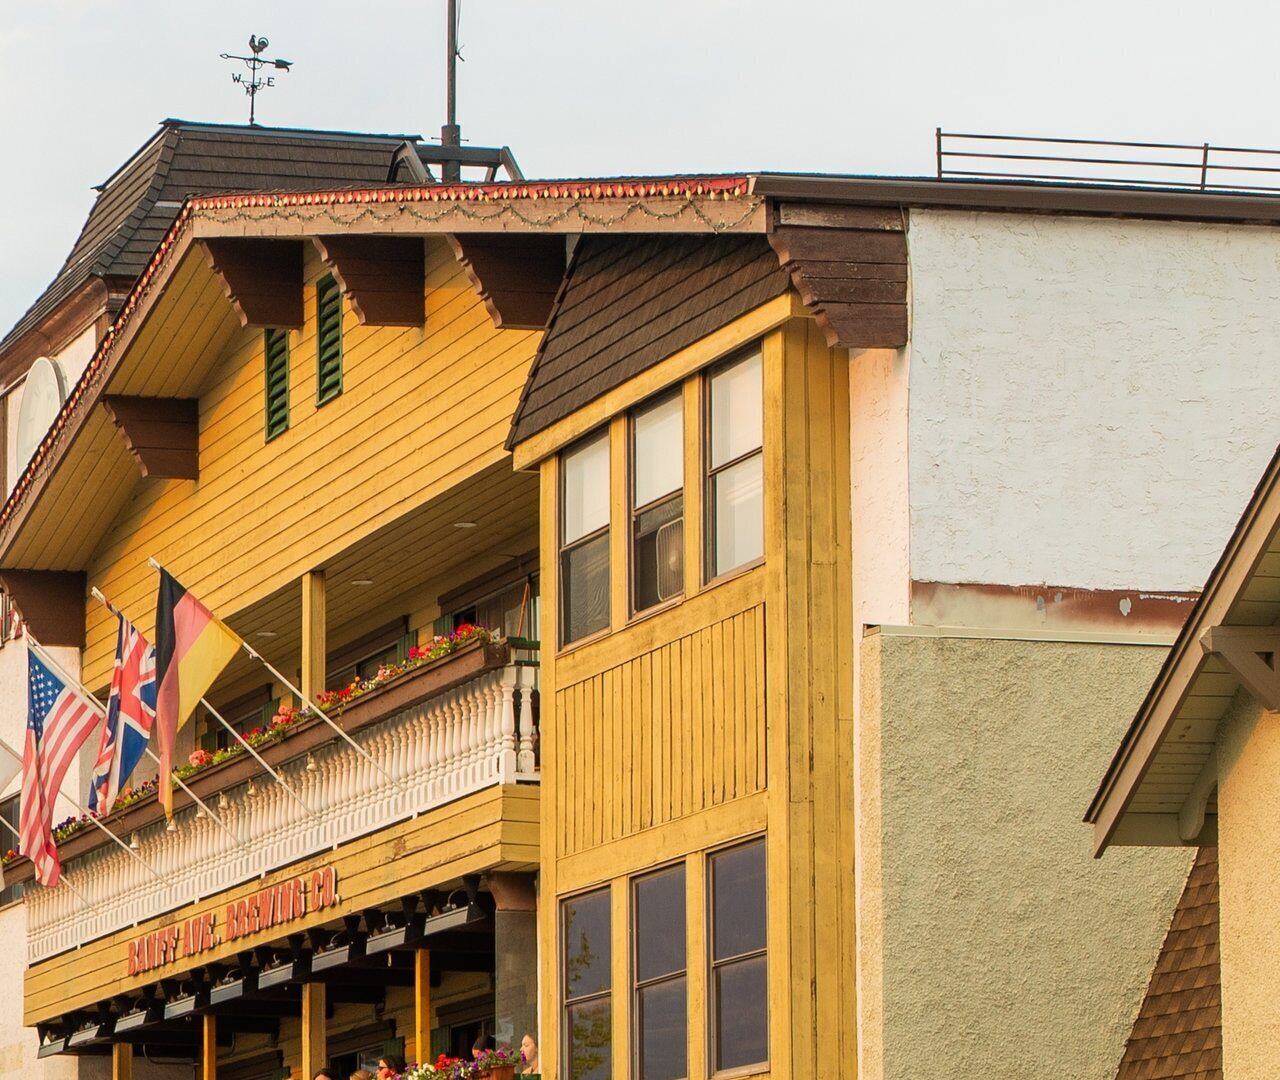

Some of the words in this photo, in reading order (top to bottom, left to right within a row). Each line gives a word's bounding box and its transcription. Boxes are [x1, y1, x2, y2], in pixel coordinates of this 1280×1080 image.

[128, 926, 178, 976] BANFF
[183, 912, 221, 957] AVE.
[226, 877, 306, 942] BREWING
[311, 866, 341, 912] CO.
